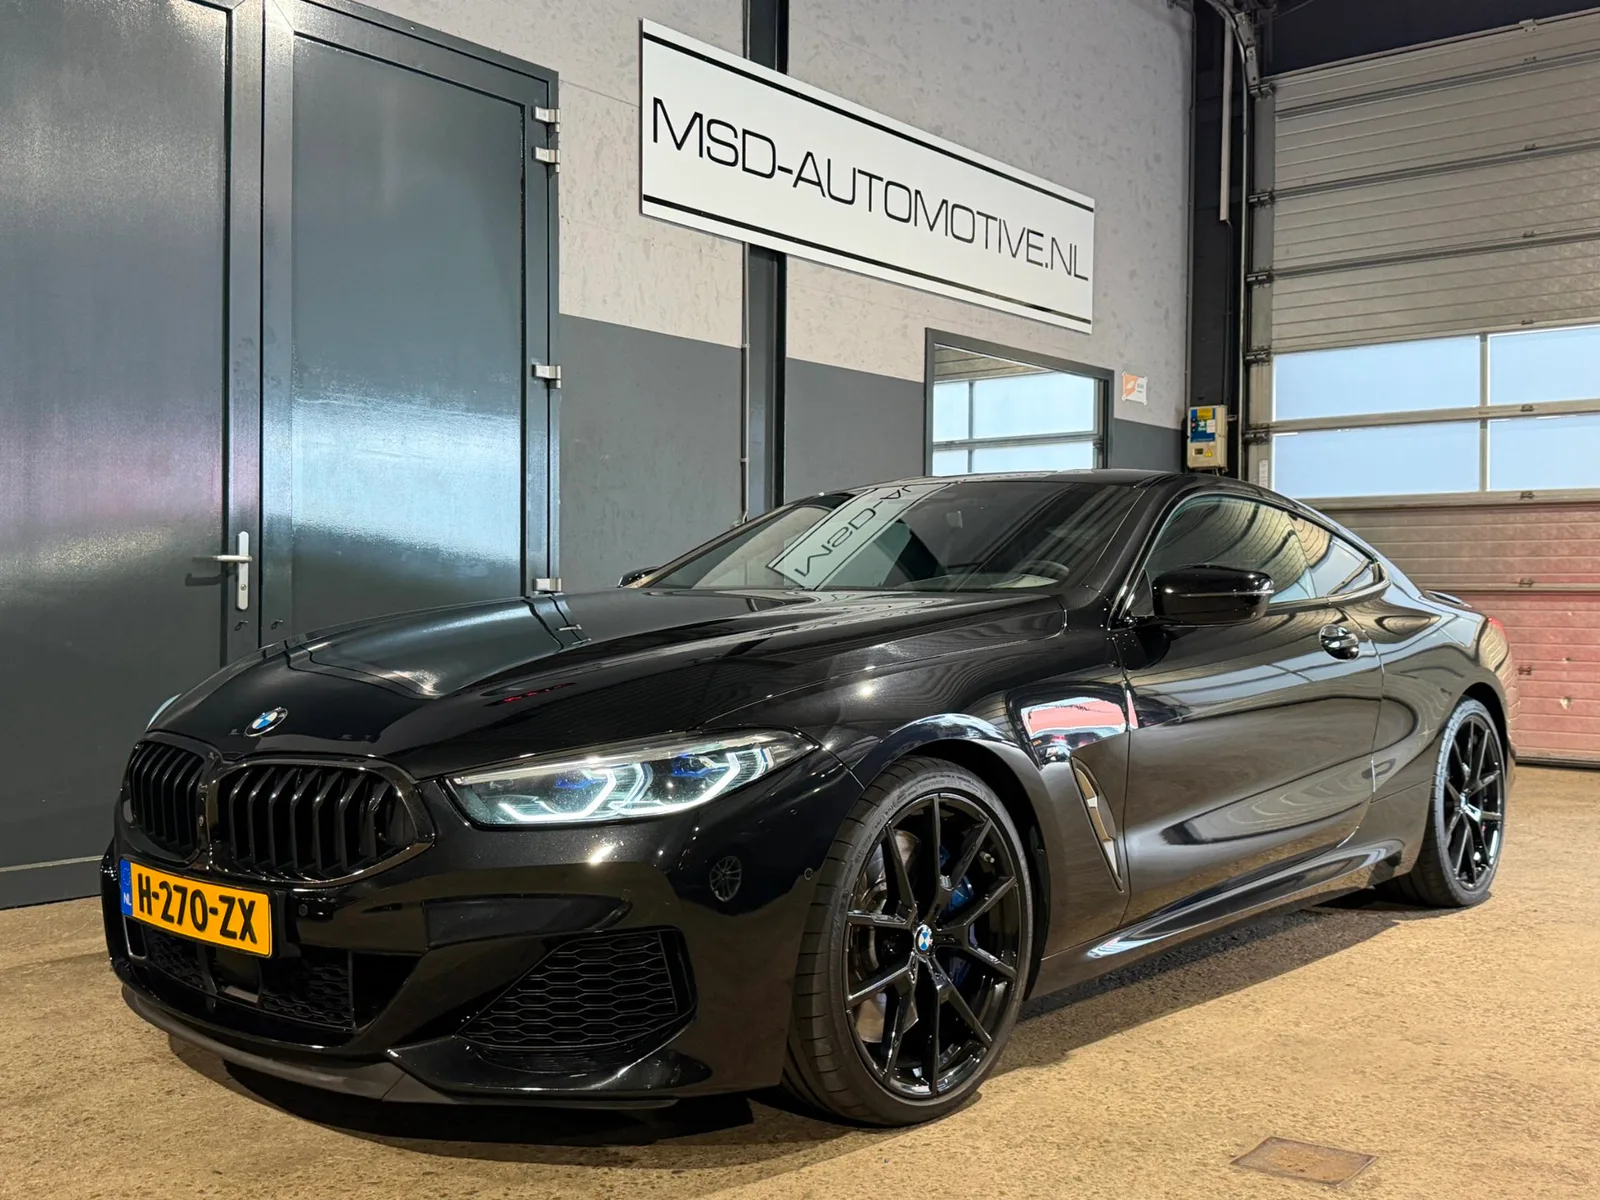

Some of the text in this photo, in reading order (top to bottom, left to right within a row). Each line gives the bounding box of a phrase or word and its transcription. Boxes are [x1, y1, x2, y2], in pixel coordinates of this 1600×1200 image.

[652, 96, 1089, 281] MSD-AUTOMOTIVE.NL
[123, 894, 132, 906] NL
[138, 873, 257, 944] H-270-ZX
